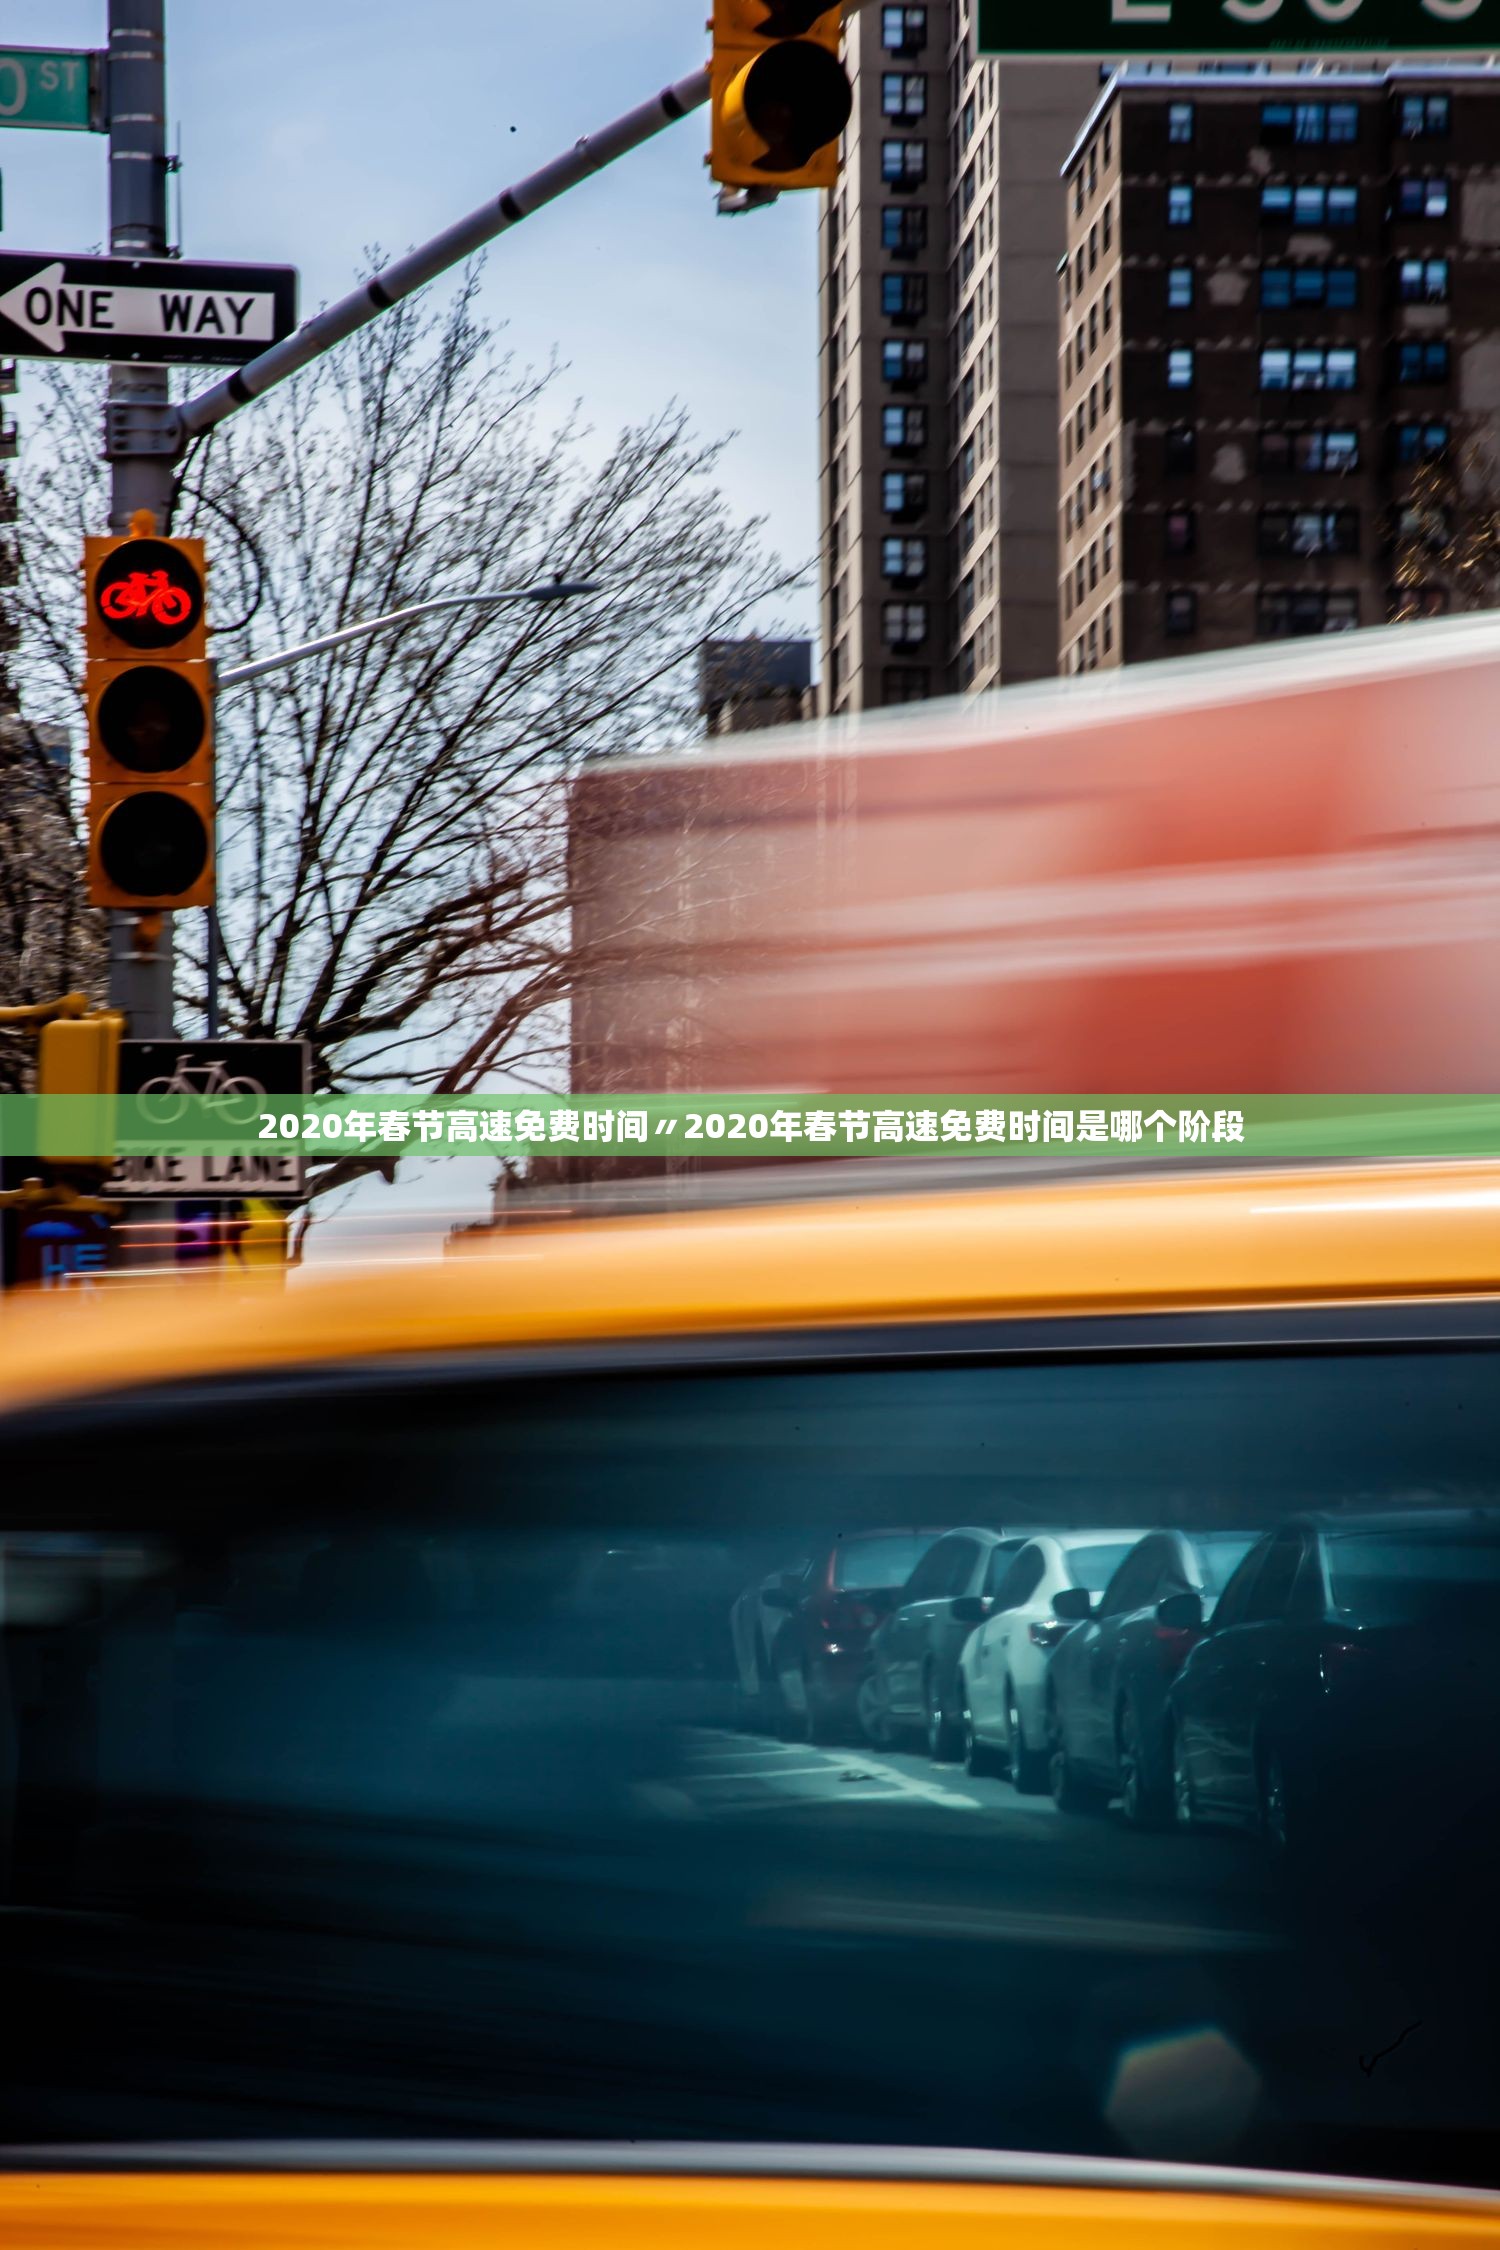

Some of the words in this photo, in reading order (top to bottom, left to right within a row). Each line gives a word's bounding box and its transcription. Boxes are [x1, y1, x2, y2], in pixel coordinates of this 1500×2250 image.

[40, 60, 80, 92] ST
[24, 286, 114, 329] ONE
[160, 294, 256, 335] WAY
[112, 1146, 187, 1182] BIKE
[202, 1146, 295, 1182] LANE
